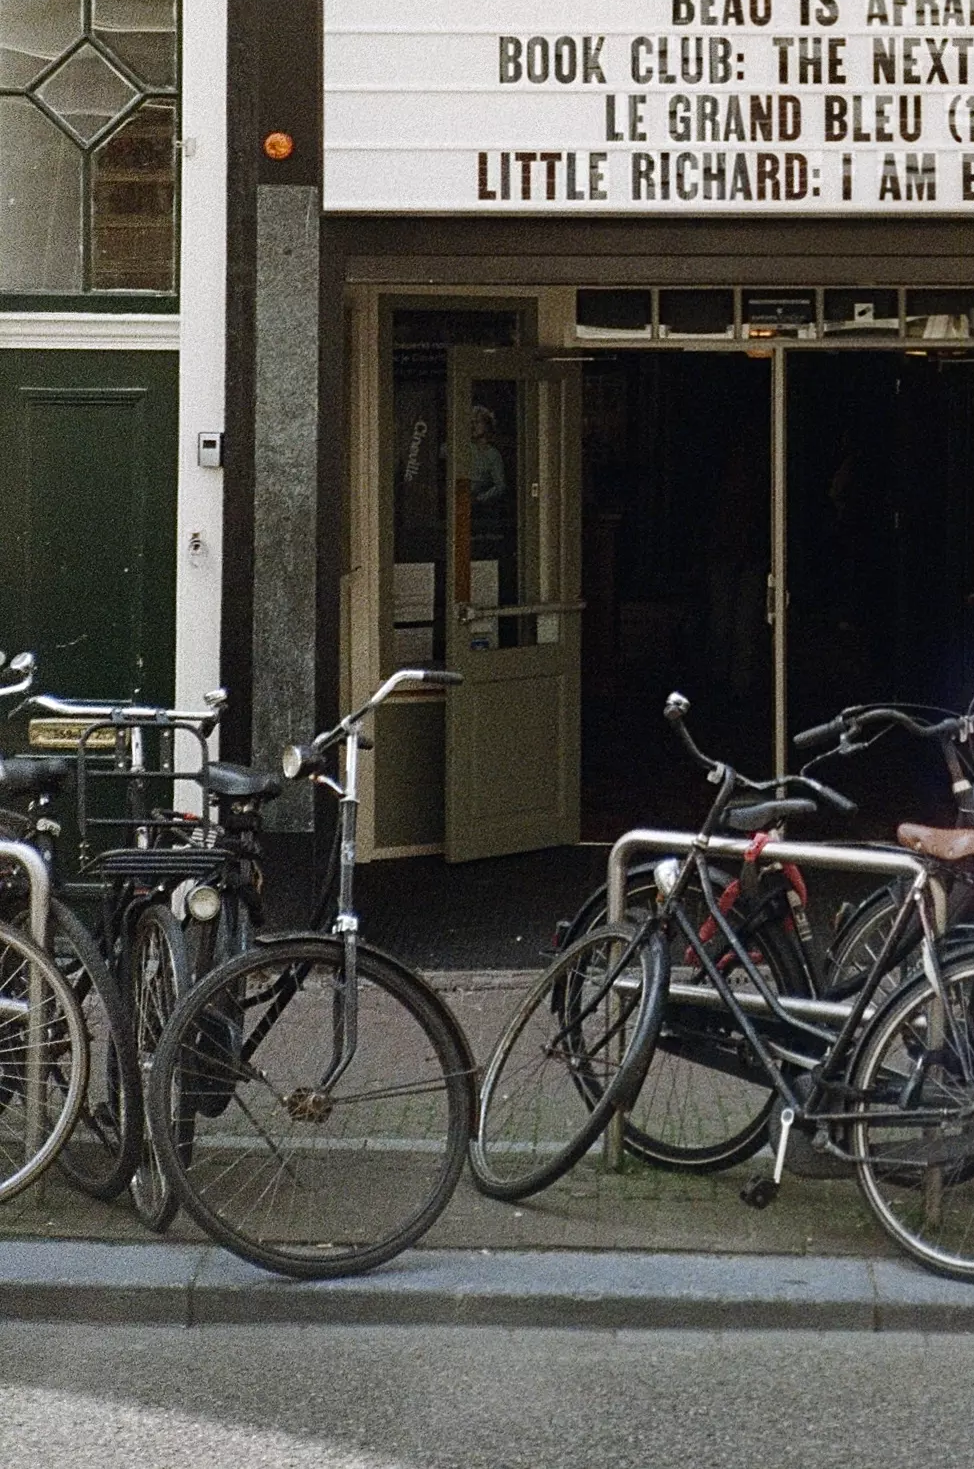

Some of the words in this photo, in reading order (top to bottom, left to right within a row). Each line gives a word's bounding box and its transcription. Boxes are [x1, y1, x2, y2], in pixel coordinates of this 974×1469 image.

[499, 35, 607, 85] BOOK
[630, 35, 745, 85] CLUB:
[772, 36, 847, 85] THE
[872, 37, 974, 85] NEXT
[605, 94, 647, 142] LE
[668, 94, 802, 143] GRAND
[824, 94, 923, 143] BLEU
[477, 151, 608, 201] LITTLE
[631, 151, 821, 201] RICHARD:
[841, 153, 853, 202] I
[878, 153, 937, 202] AM
